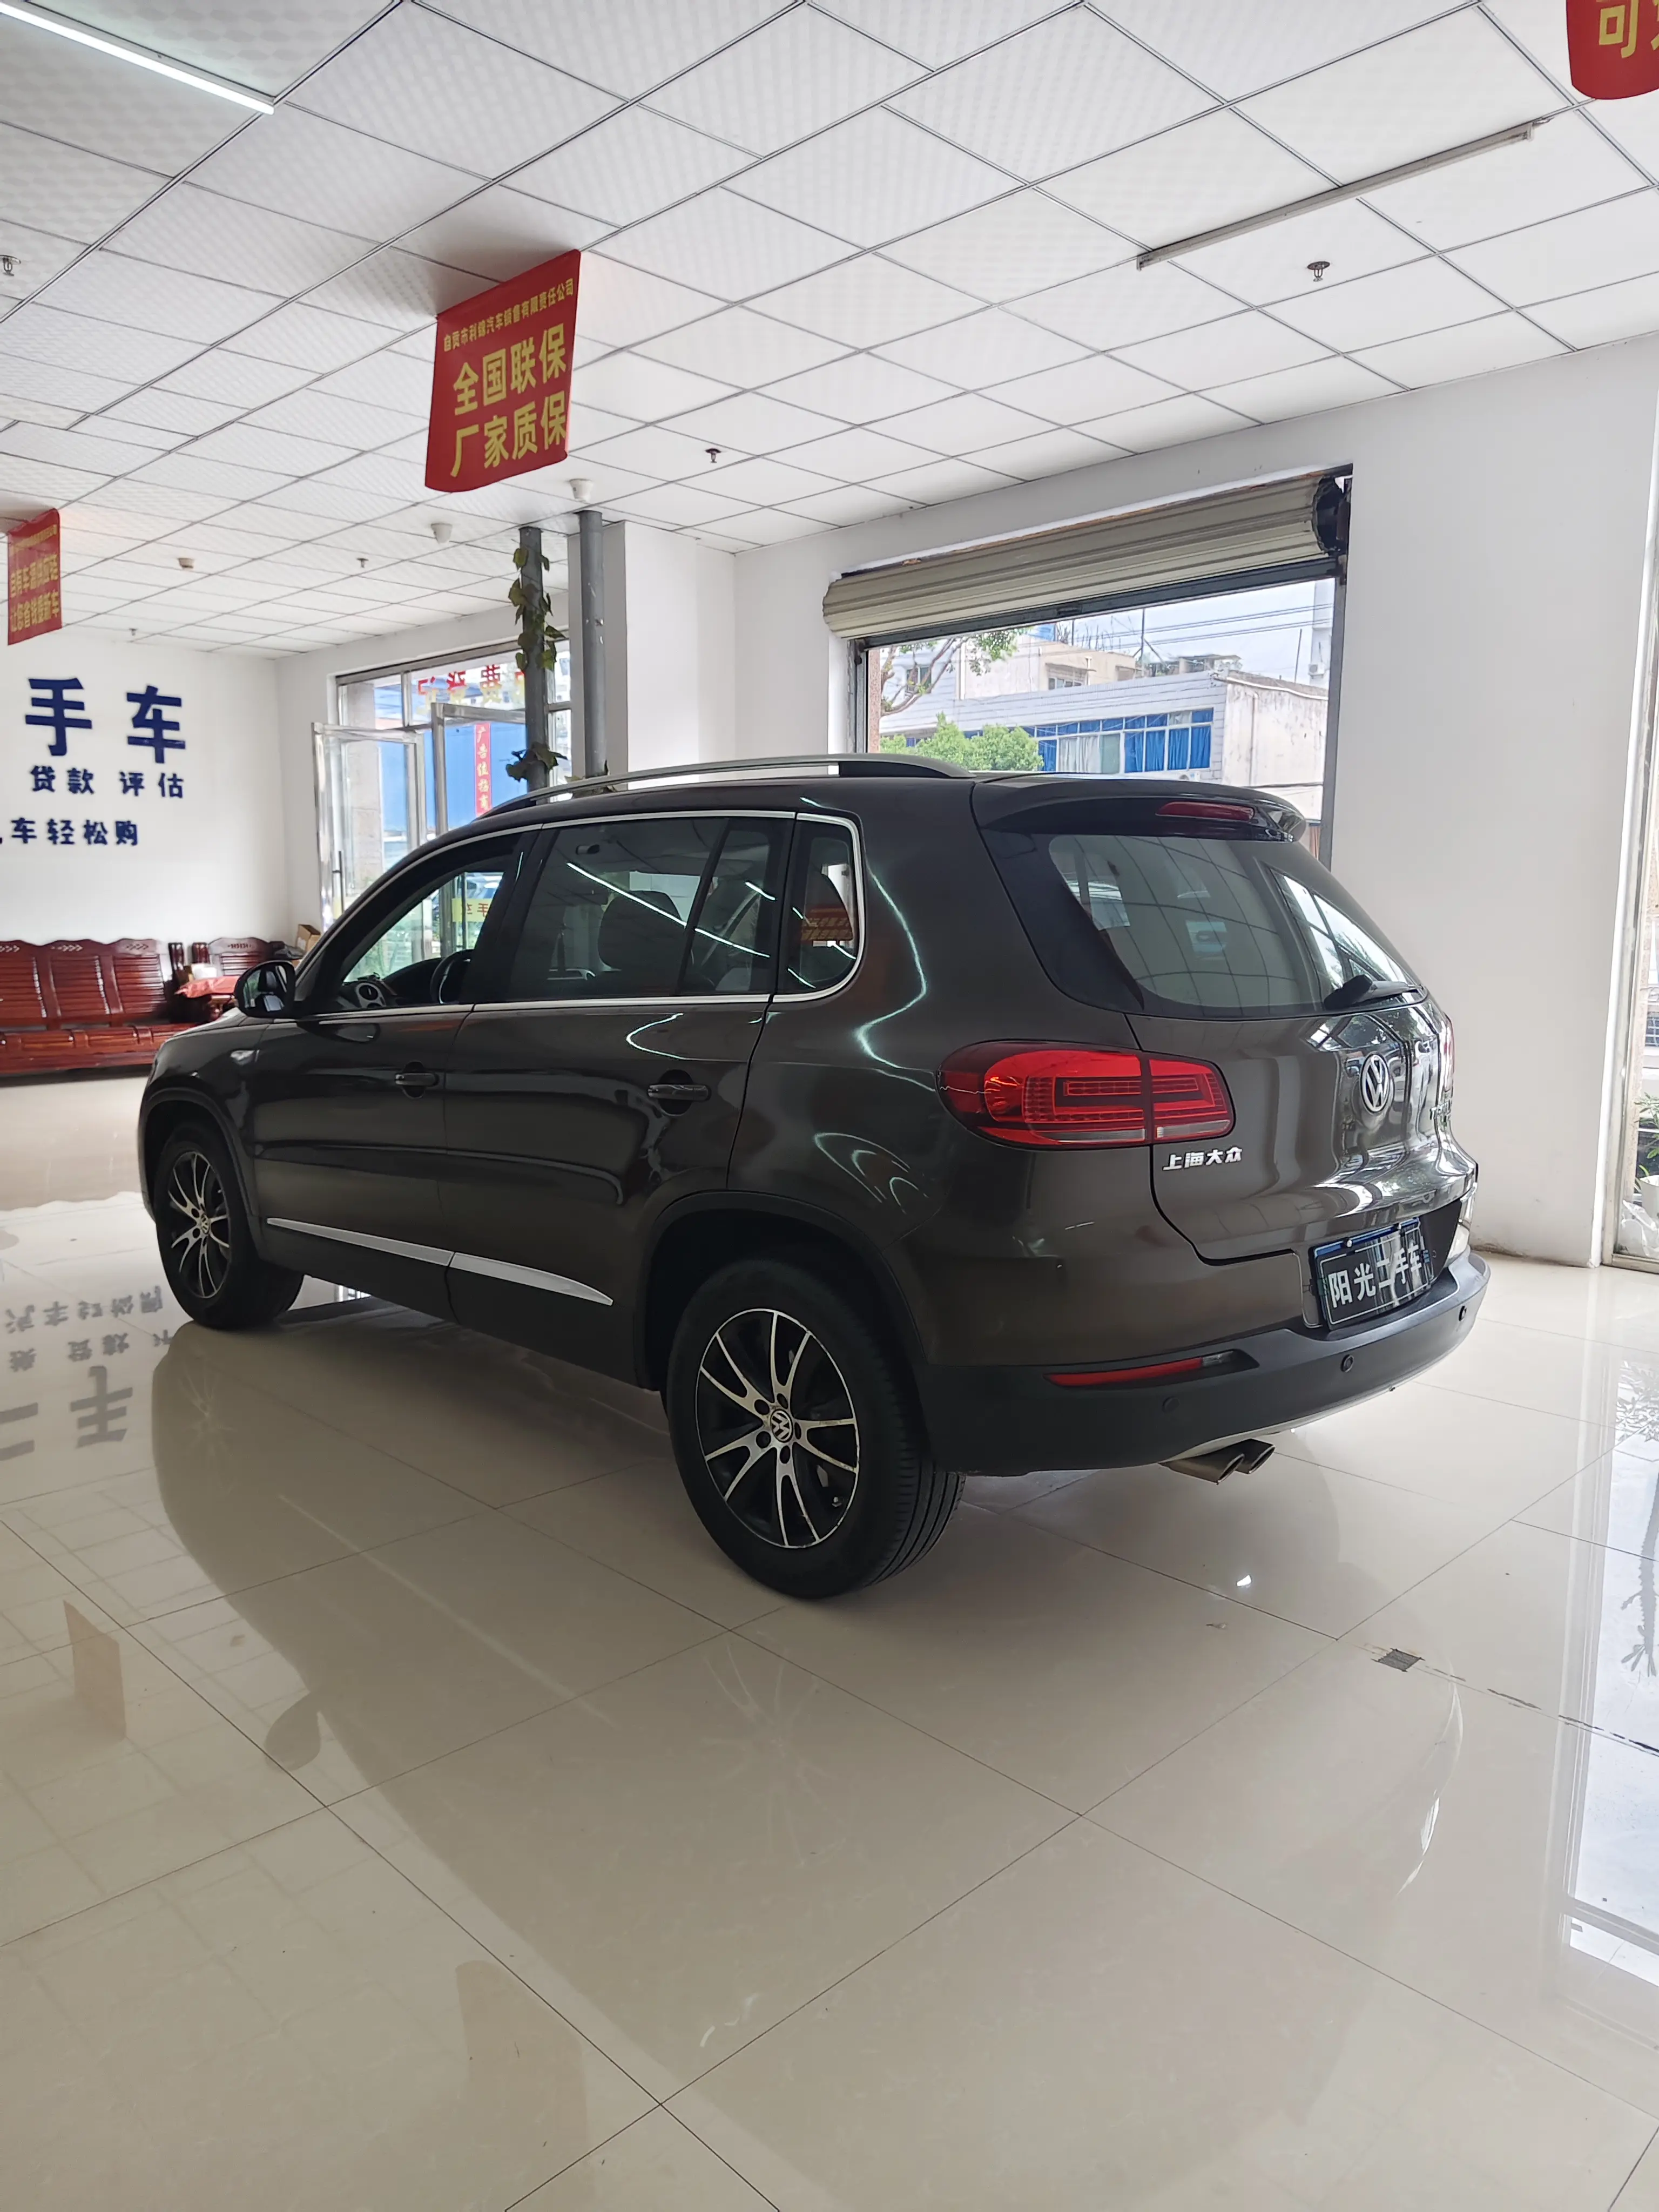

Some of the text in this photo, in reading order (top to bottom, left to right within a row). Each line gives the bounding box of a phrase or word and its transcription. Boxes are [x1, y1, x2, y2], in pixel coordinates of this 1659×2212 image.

[1596, 0, 1659, 59] 可
[453, 323, 567, 416] 全国联保
[450, 390, 568, 478] 厂家质保
[31, 765, 184, 799] 贷款 评估
[0, 817, 139, 846] 车轻松购
[1163, 1147, 1243, 1171] 上海大众
[1328, 1239, 1422, 1308] 阳光二手车
